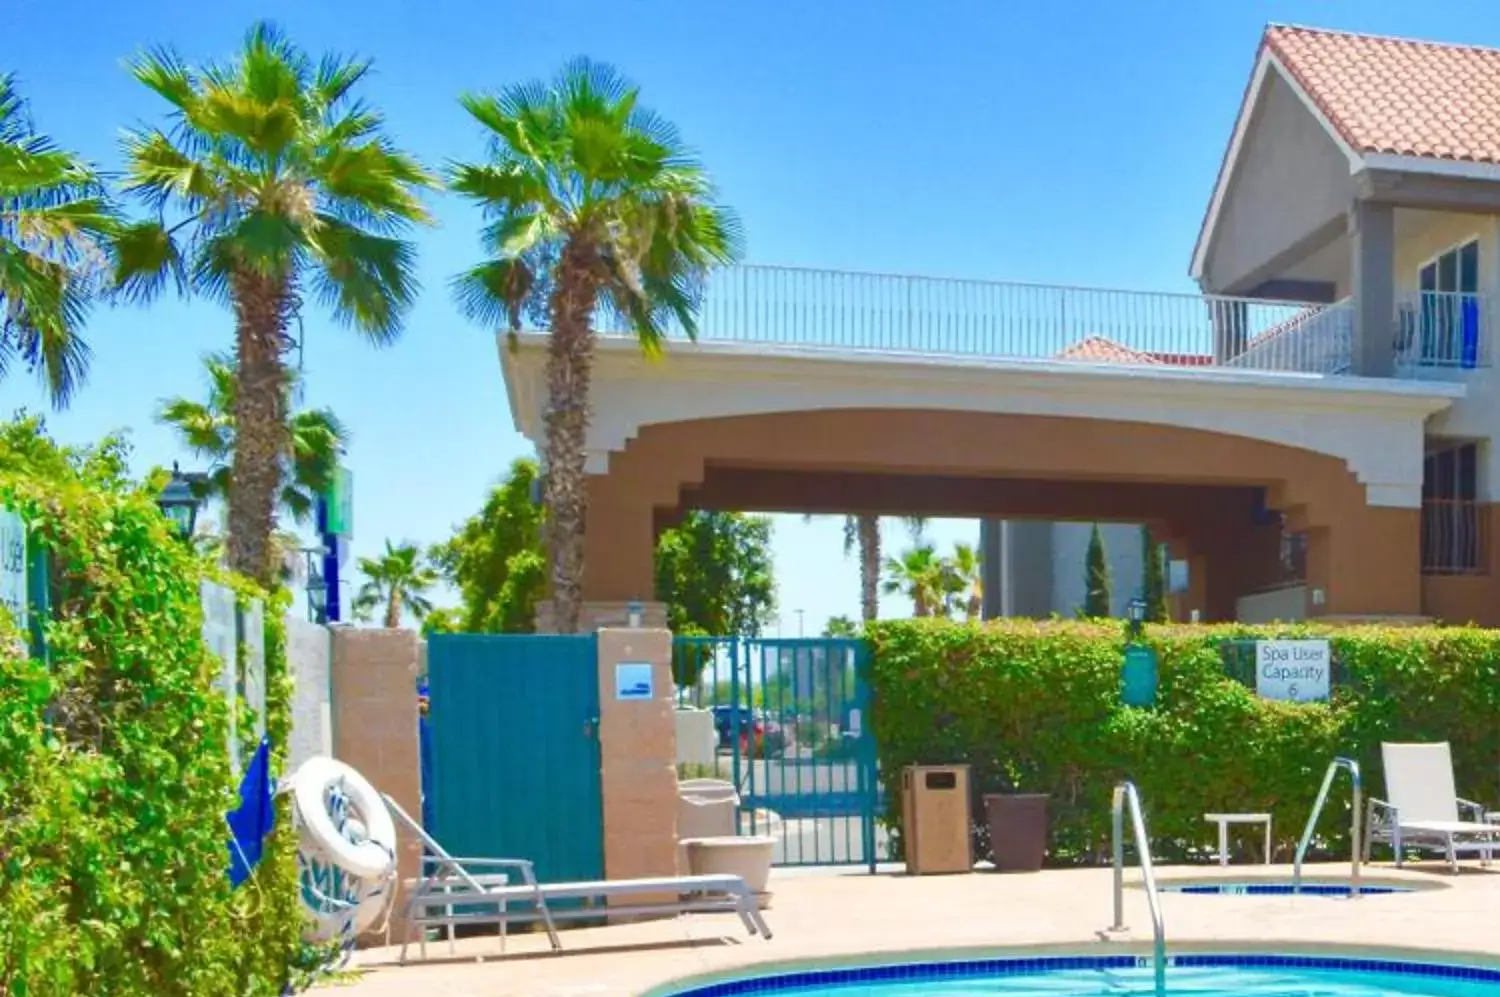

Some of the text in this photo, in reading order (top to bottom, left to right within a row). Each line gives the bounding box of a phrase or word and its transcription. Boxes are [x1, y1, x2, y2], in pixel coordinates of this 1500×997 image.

[1262, 646, 1324, 662] Spa User
[1262, 662, 1325, 682] Capacity
[1287, 683, 1298, 696] 6
